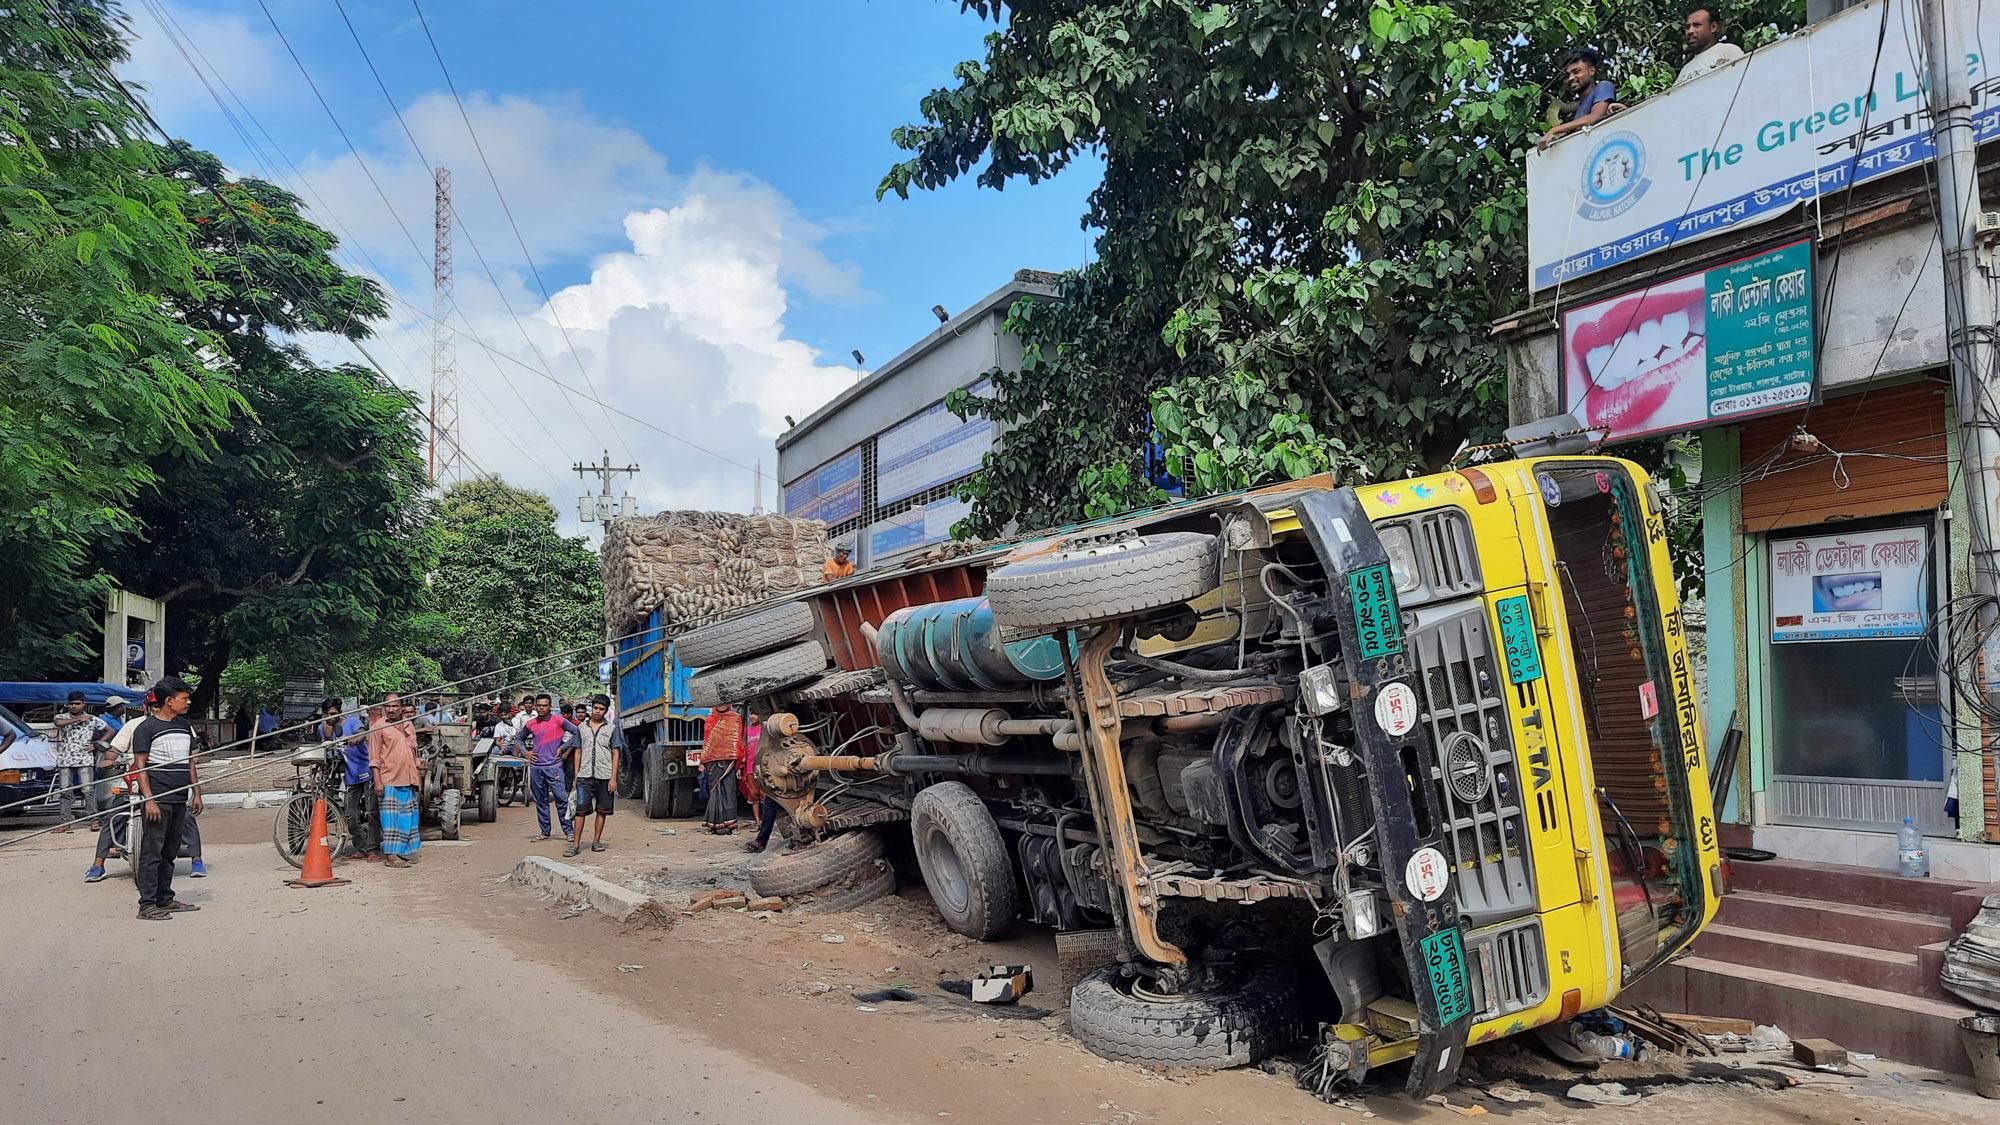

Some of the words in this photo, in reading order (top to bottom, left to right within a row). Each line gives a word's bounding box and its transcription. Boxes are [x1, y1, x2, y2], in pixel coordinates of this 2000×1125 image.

[1677, 143, 1743, 181] The
[1757, 91, 1877, 152] Green
[1895, 53, 1979, 103] Lie
[1710, 279, 1735, 319] লাকী
[1738, 273, 1772, 313] ডেন্টাল
[1775, 267, 1806, 303] কেয়ার
[1776, 541, 1811, 575] লাকী
[1816, 538, 1866, 572] ডেন্টাল
[1872, 537, 1920, 568] কেয়ার
[1371, 570, 1387, 602] ঢাকা
[1513, 603, 1525, 627] ঢাকা
[1501, 603, 1523, 678] ২০-৯৫০৫
[1518, 631, 1532, 660] মেট্রো
[1521, 708, 1552, 791] TATA
